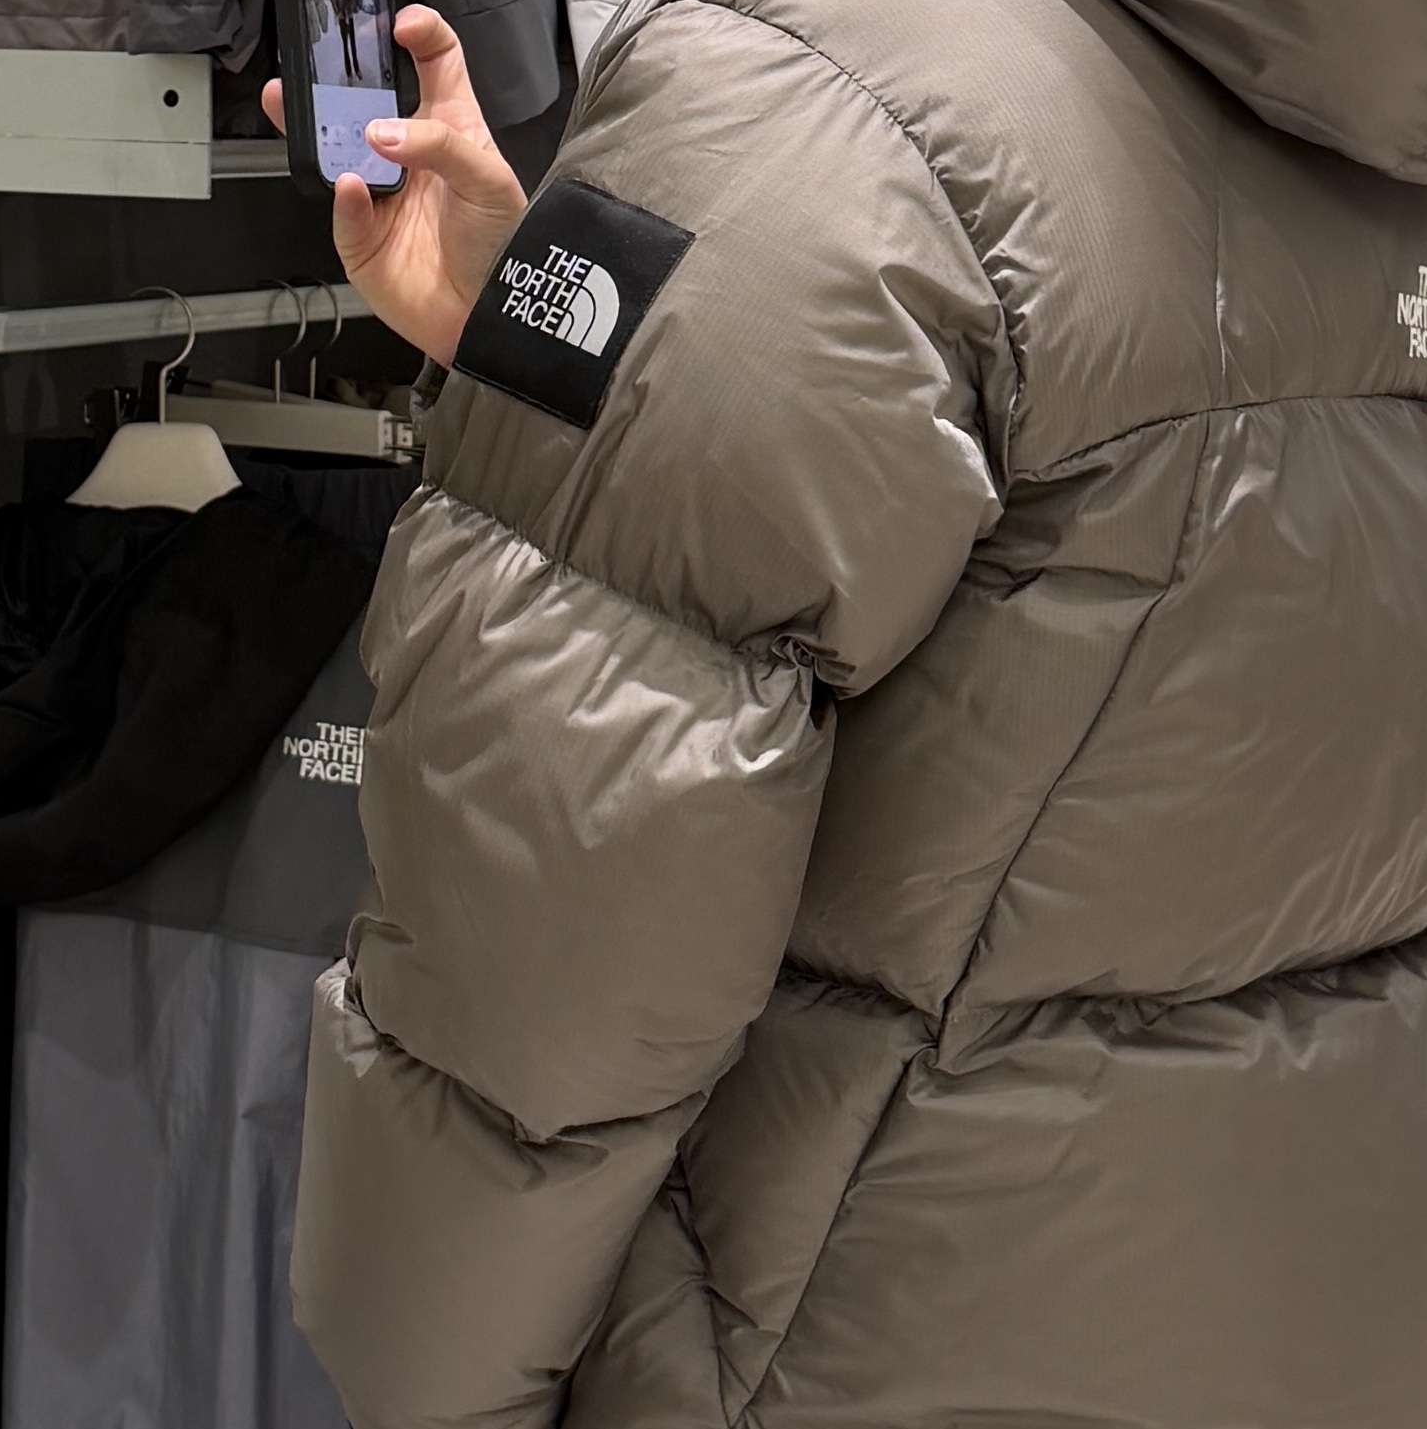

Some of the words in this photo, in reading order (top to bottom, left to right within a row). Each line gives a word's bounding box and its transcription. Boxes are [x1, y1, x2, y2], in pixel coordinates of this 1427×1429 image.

[543, 244, 592, 284] THE
[499, 257, 577, 309] NORTH
[502, 291, 565, 335] FACE
[283, 736, 358, 763] NORTH
[316, 722, 359, 745] THE
[299, 758, 356, 783] FACE
